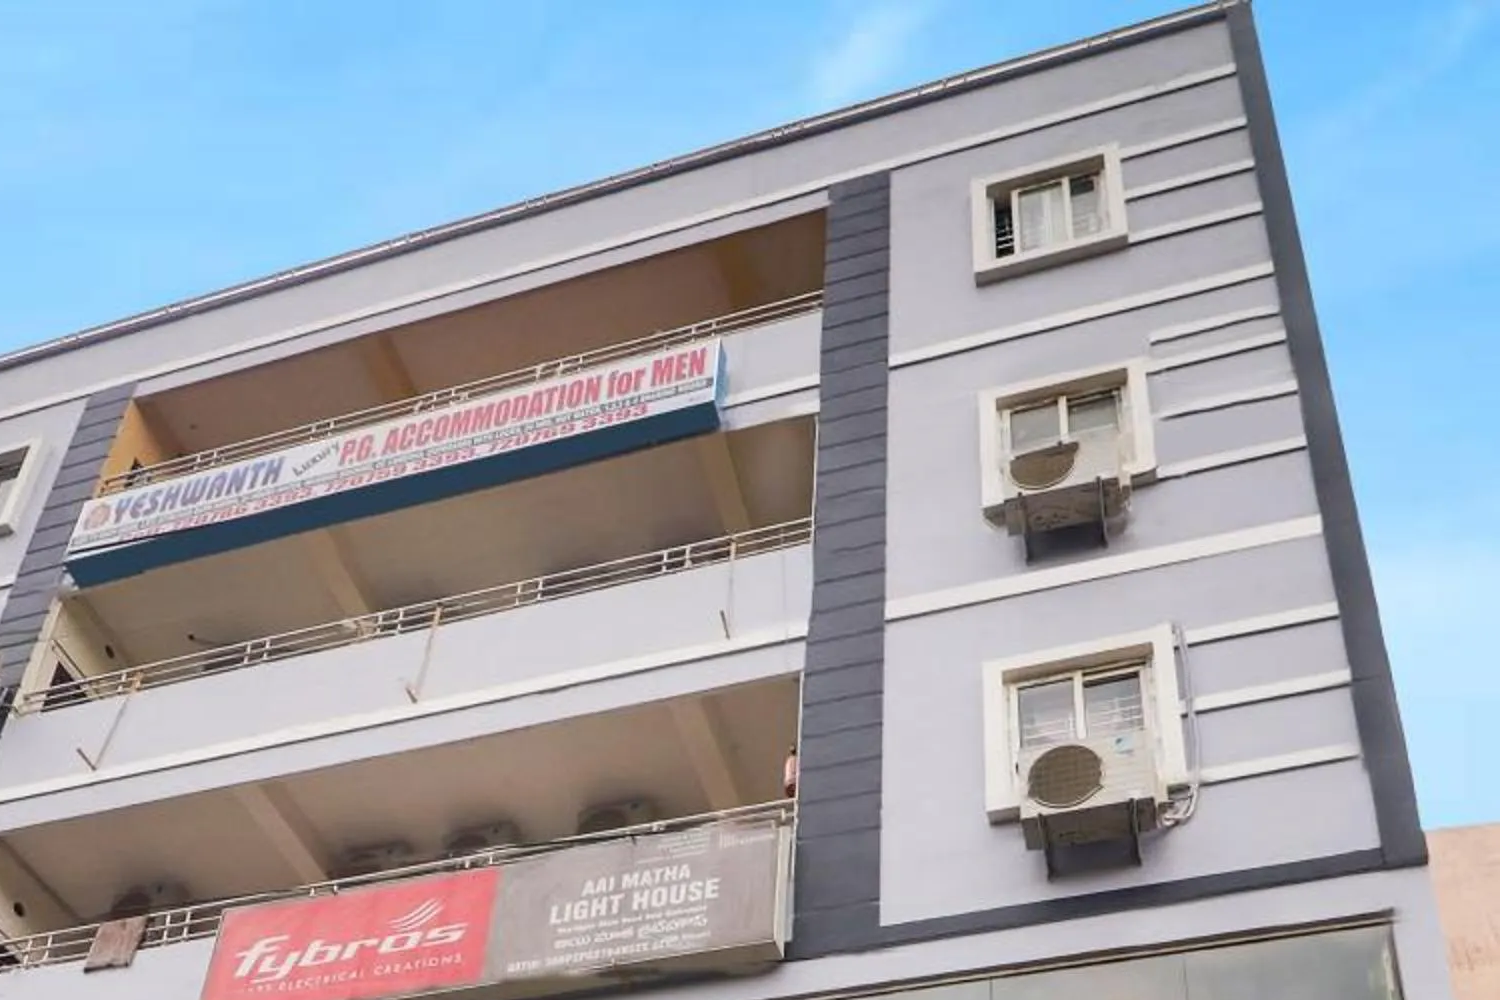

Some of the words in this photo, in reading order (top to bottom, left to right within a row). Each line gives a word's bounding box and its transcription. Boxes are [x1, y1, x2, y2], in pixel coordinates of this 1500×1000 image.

[114, 456, 285, 523] YESHWANTH
[339, 434, 377, 468] P.G.
[381, 376, 600, 455] ACCOMMODATION
[608, 367, 647, 398] for
[650, 347, 707, 388] MEN
[549, 893, 625, 925] LIGHT
[632, 878, 721, 911] HOUSE
[581, 877, 615, 897] AAI
[622, 864, 691, 889] MATHA
[234, 922, 468, 983] fybros
